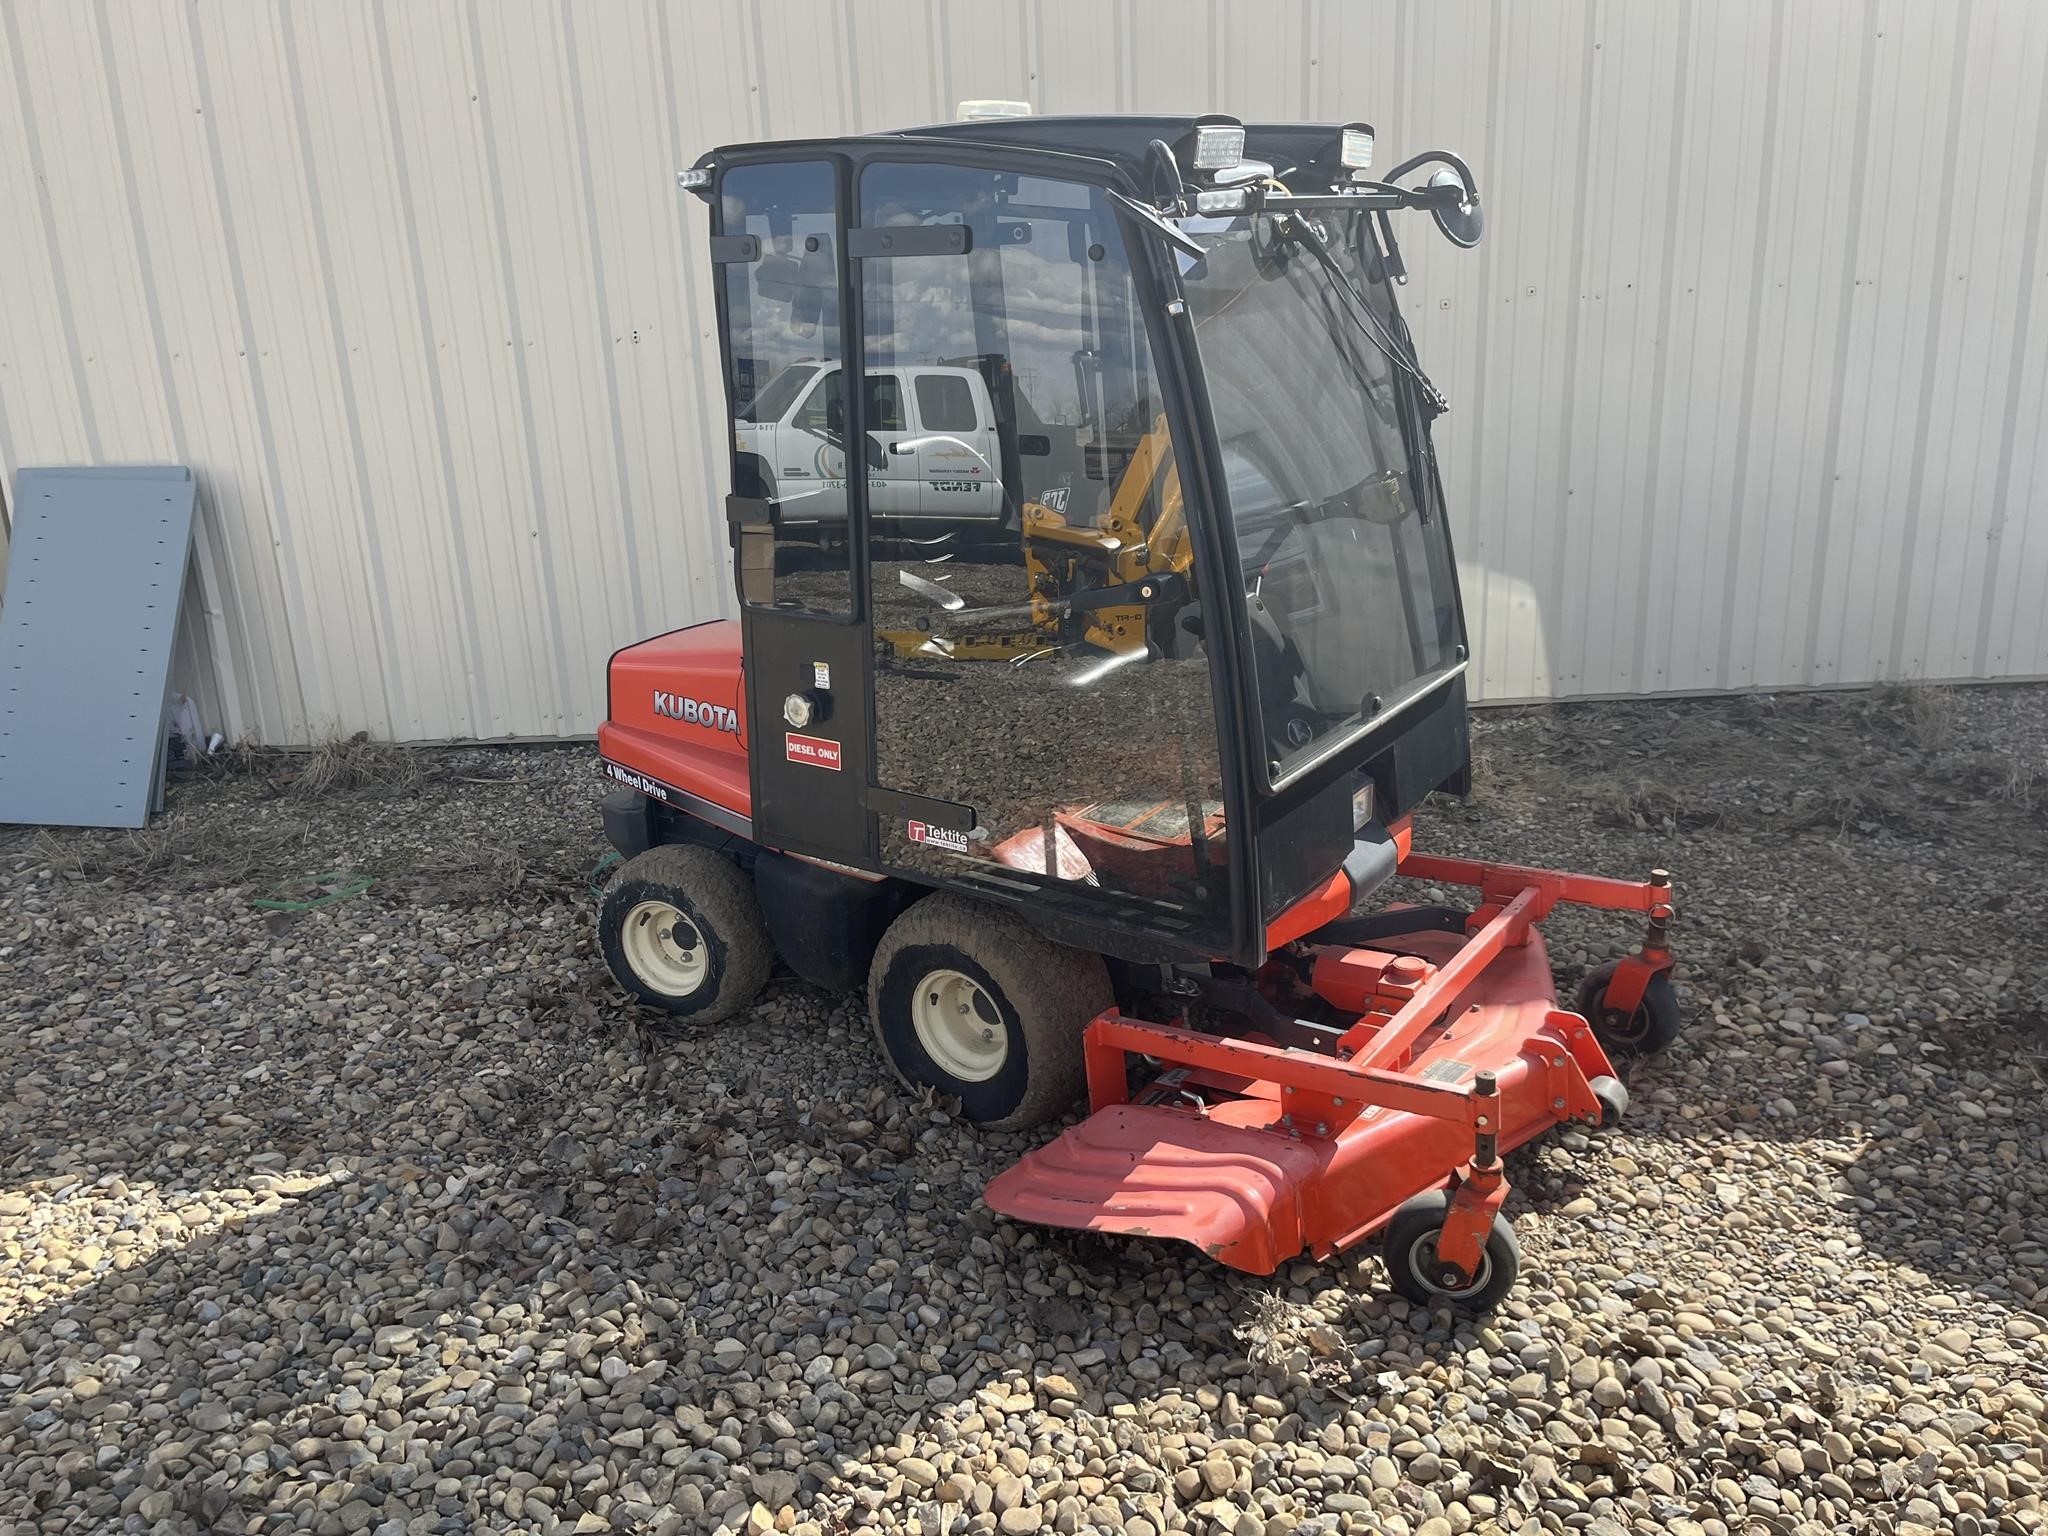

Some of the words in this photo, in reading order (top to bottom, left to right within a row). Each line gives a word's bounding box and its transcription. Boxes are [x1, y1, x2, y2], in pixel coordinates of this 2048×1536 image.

[653, 689, 741, 736] KUBOTA
[788, 742, 816, 756] DIESEL
[818, 748, 838, 760] ONLY
[606, 764, 613, 777] 4
[612, 765, 642, 789] Wheel
[642, 777, 667, 800] Drive
[926, 824, 968, 845] Tektite
